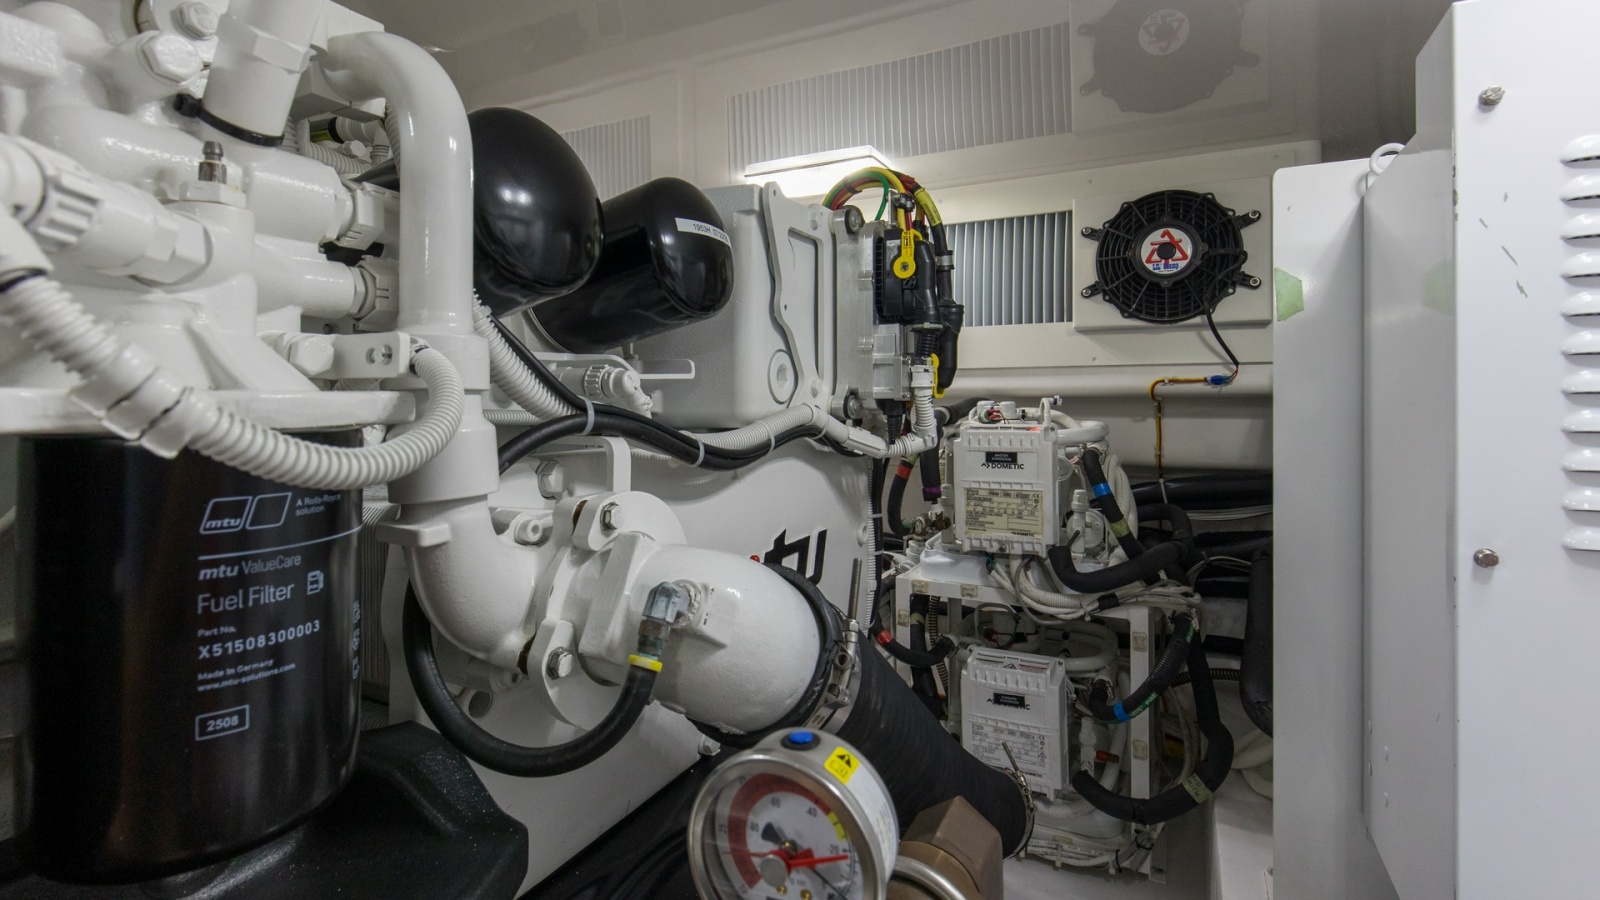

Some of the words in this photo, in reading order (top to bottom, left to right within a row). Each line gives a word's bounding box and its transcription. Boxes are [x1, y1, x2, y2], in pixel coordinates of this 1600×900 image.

[295, 498, 303, 507] A
[295, 505, 325, 517] solution
[204, 517, 242, 530] mtu
[198, 563, 239, 581] mtu
[241, 554, 302, 575] ValueCare
[197, 589, 244, 615] Fuel
[248, 583, 296, 607] Filter
[197, 627, 219, 638] Part
[219, 625, 237, 636] No.
[198, 619, 321, 660] X51508300003
[197, 667, 225, 681] Made
[236, 658, 275, 674] Germany
[197, 662, 296, 692] www.mtu-solutions.com
[206, 715, 240, 732] 2508
